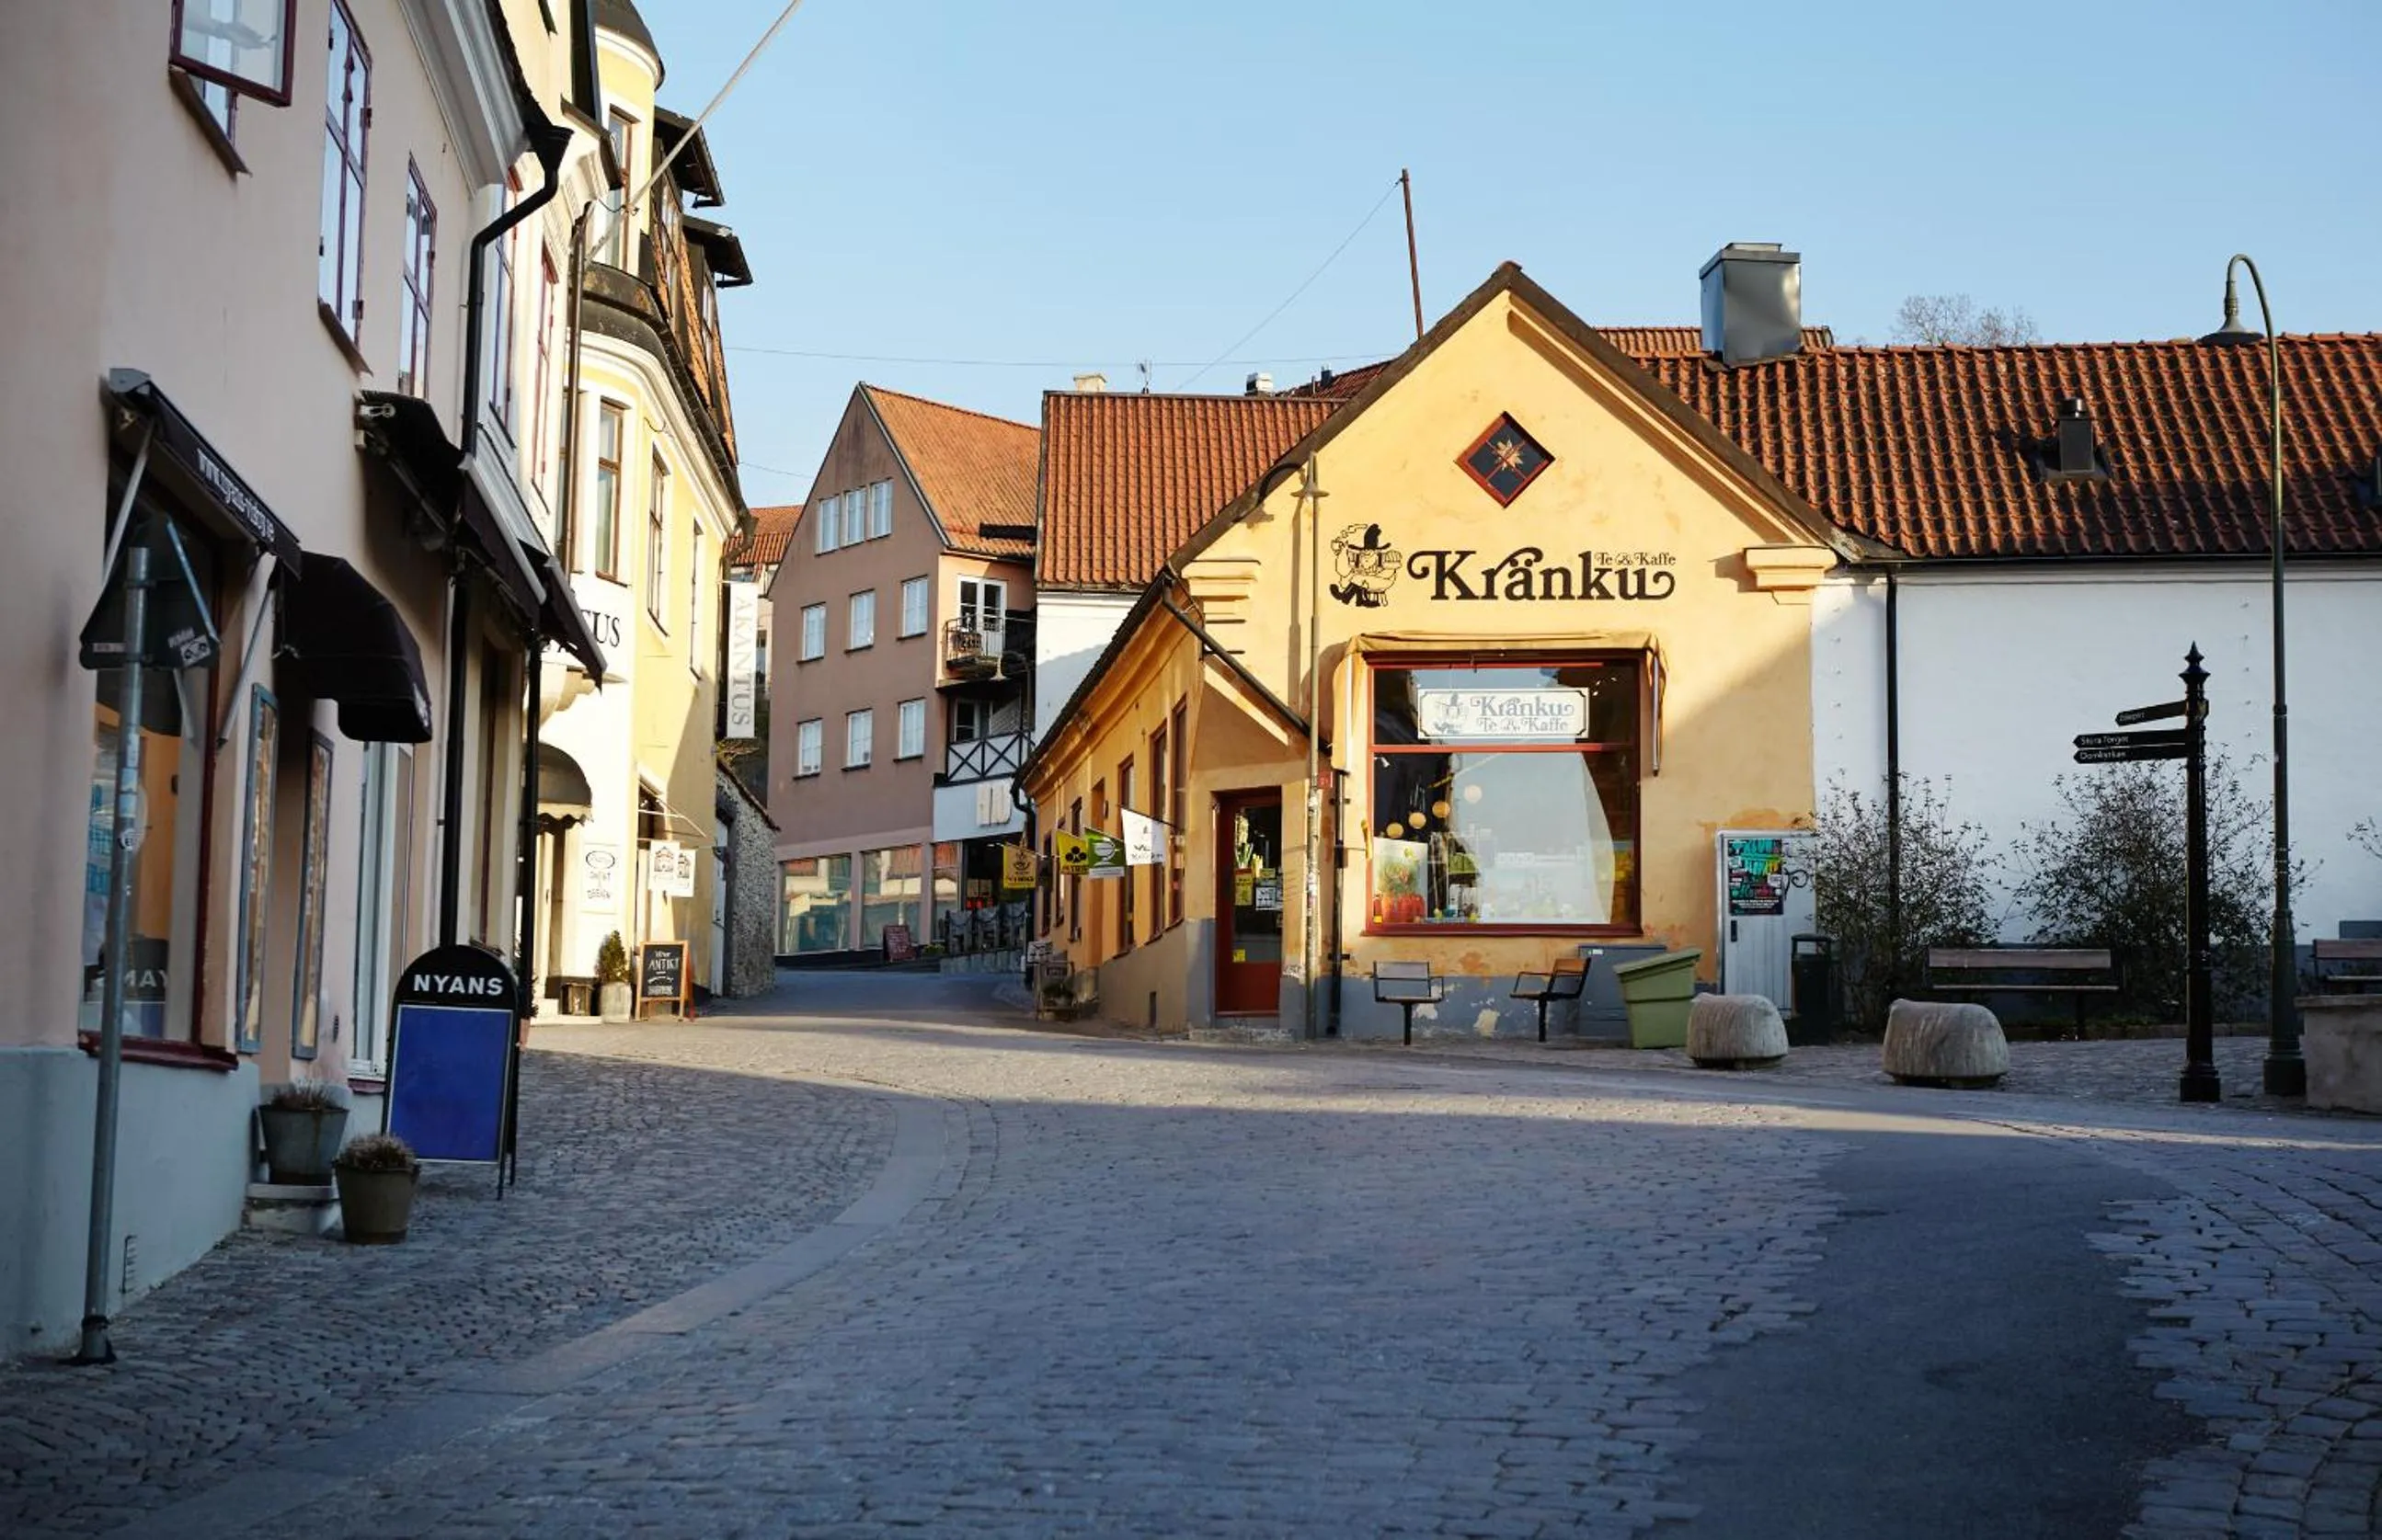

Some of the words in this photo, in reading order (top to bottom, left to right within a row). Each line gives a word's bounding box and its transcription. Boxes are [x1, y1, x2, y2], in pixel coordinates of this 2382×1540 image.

[1594, 552, 1613, 565] Te
[1634, 552, 1677, 565] Kaffe
[1407, 547, 1676, 601] Kränku
[1470, 695, 1575, 717] Kränku
[1477, 717, 1497, 733] Te
[1521, 717, 1569, 733] Kaffe
[413, 974, 504, 997] NYANS
